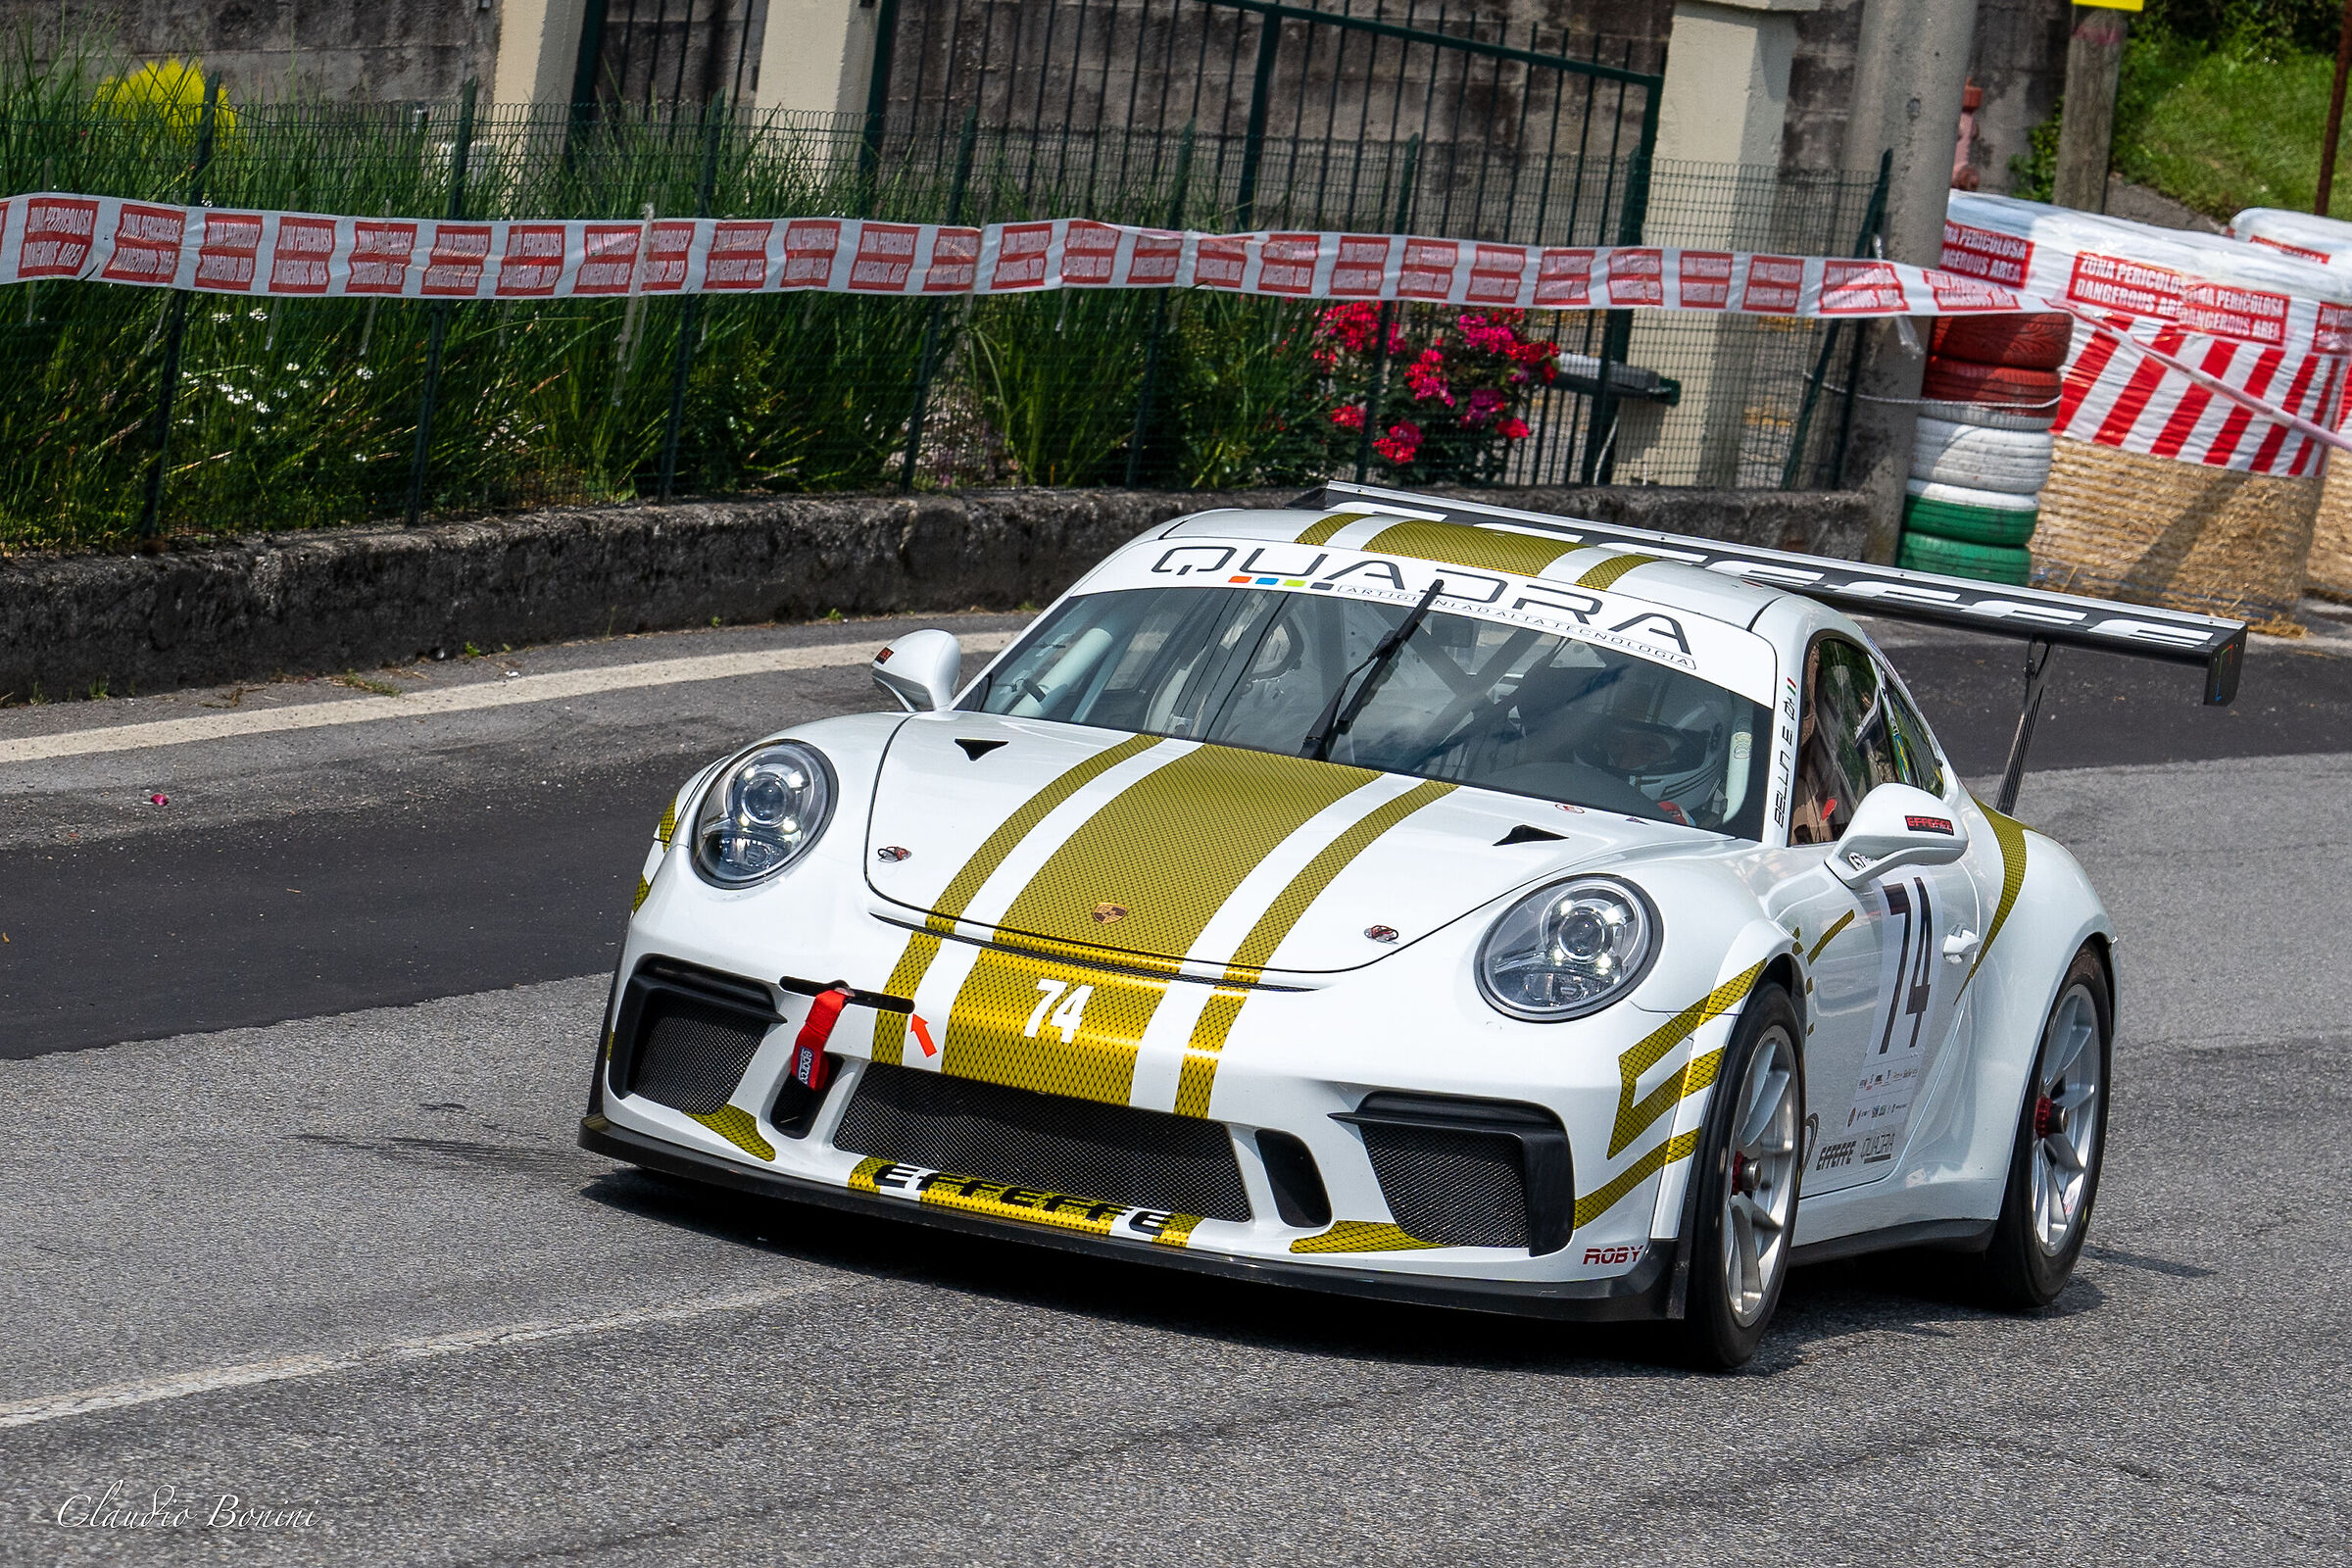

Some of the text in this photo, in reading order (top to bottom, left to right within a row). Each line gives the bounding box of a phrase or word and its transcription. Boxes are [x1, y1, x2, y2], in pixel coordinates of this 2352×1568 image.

[1959, 227, 2027, 260] PERICOLOSA
[1941, 249, 2022, 282] NGEROUS AREA
[2080, 255, 2186, 296] ZONA PERICOLO
[2075, 278, 2156, 313] DANGEROUS
[2216, 288, 2284, 318] PERICOLOSA
[2252, 319, 2280, 341] AREA
[1151, 546, 1691, 656] QUADRA
[1348, 586, 1455, 608] ARTIGINI
[1554, 622, 1690, 666] TECNOLOGIA
[1879, 876, 1933, 1055] 74
[1023, 978, 1095, 1044] 74
[872, 1163, 1171, 1236] EFFEFFE
[1583, 1245, 1644, 1265] ROBY
